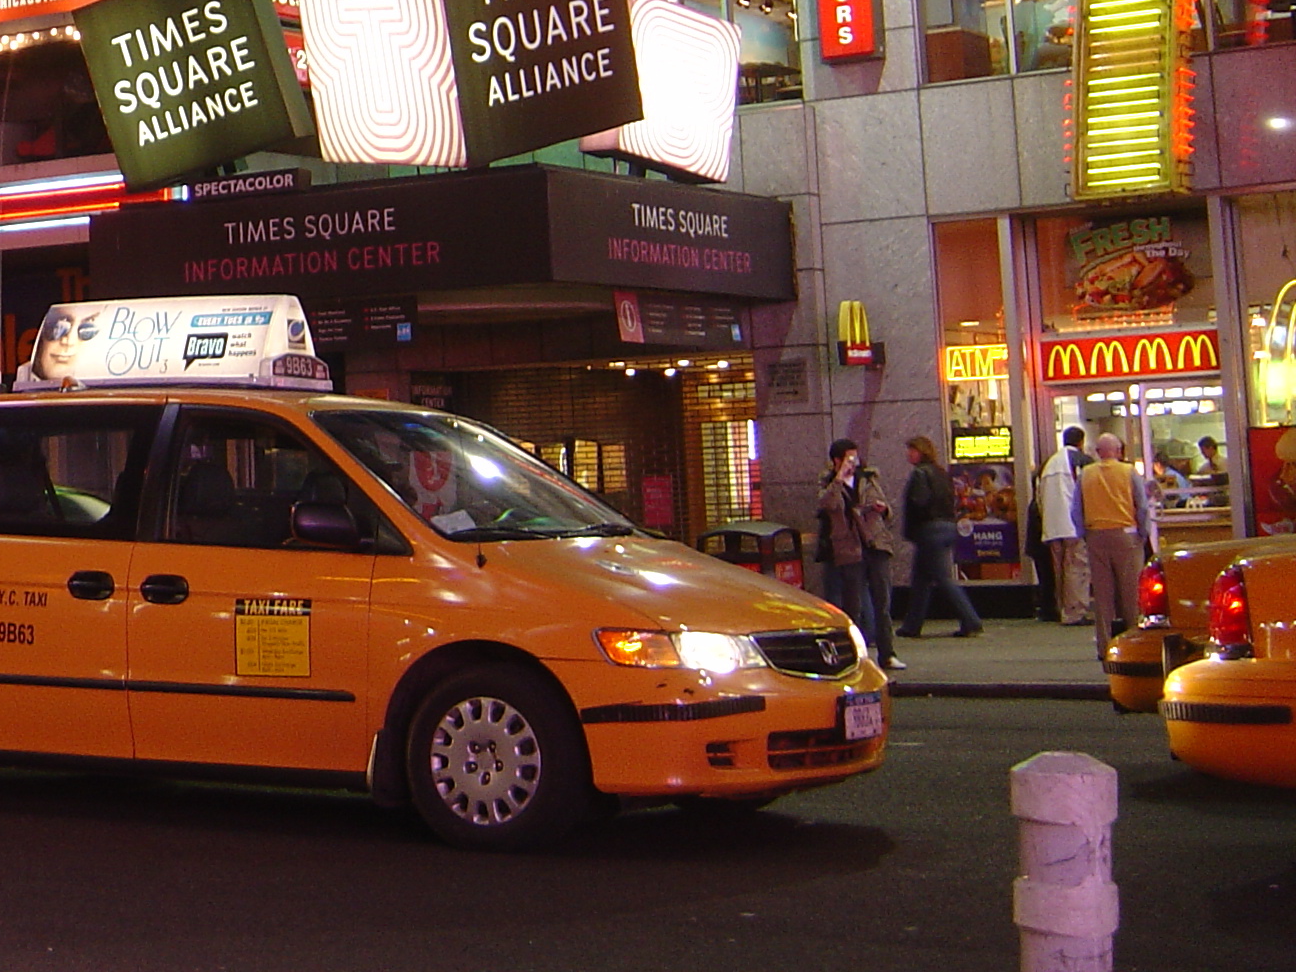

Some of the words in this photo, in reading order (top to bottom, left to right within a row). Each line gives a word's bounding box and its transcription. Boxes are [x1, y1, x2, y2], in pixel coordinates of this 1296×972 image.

[111, 0, 228, 67] TIMES
[114, 35, 256, 114] SQUARE
[488, 48, 614, 107] ALLIANCE
[138, 81, 259, 147] ALLIANCE
[194, 173, 294, 197] SPECTACOLOR
[224, 216, 295, 244] TIMES
[304, 207, 396, 240] SQUARE
[631, 203, 675, 232] TIMES
[678, 210, 729, 238] SQUARE
[608, 237, 700, 268] INFORMATION
[704, 248, 752, 274] CENTER
[1070, 216, 1171, 265] FRESH
[1168, 247, 1191, 259] Day
[184, 249, 338, 283] INFORMATION
[347, 241, 441, 271] CENTER
[186, 335, 225, 357] Bravo
[950, 349, 994, 378] ATM
[285, 356, 314, 377] 9B63
[24, 591, 48, 607] TAXI
[244, 599, 270, 615] TAXI
[274, 599, 304, 615] FARE
